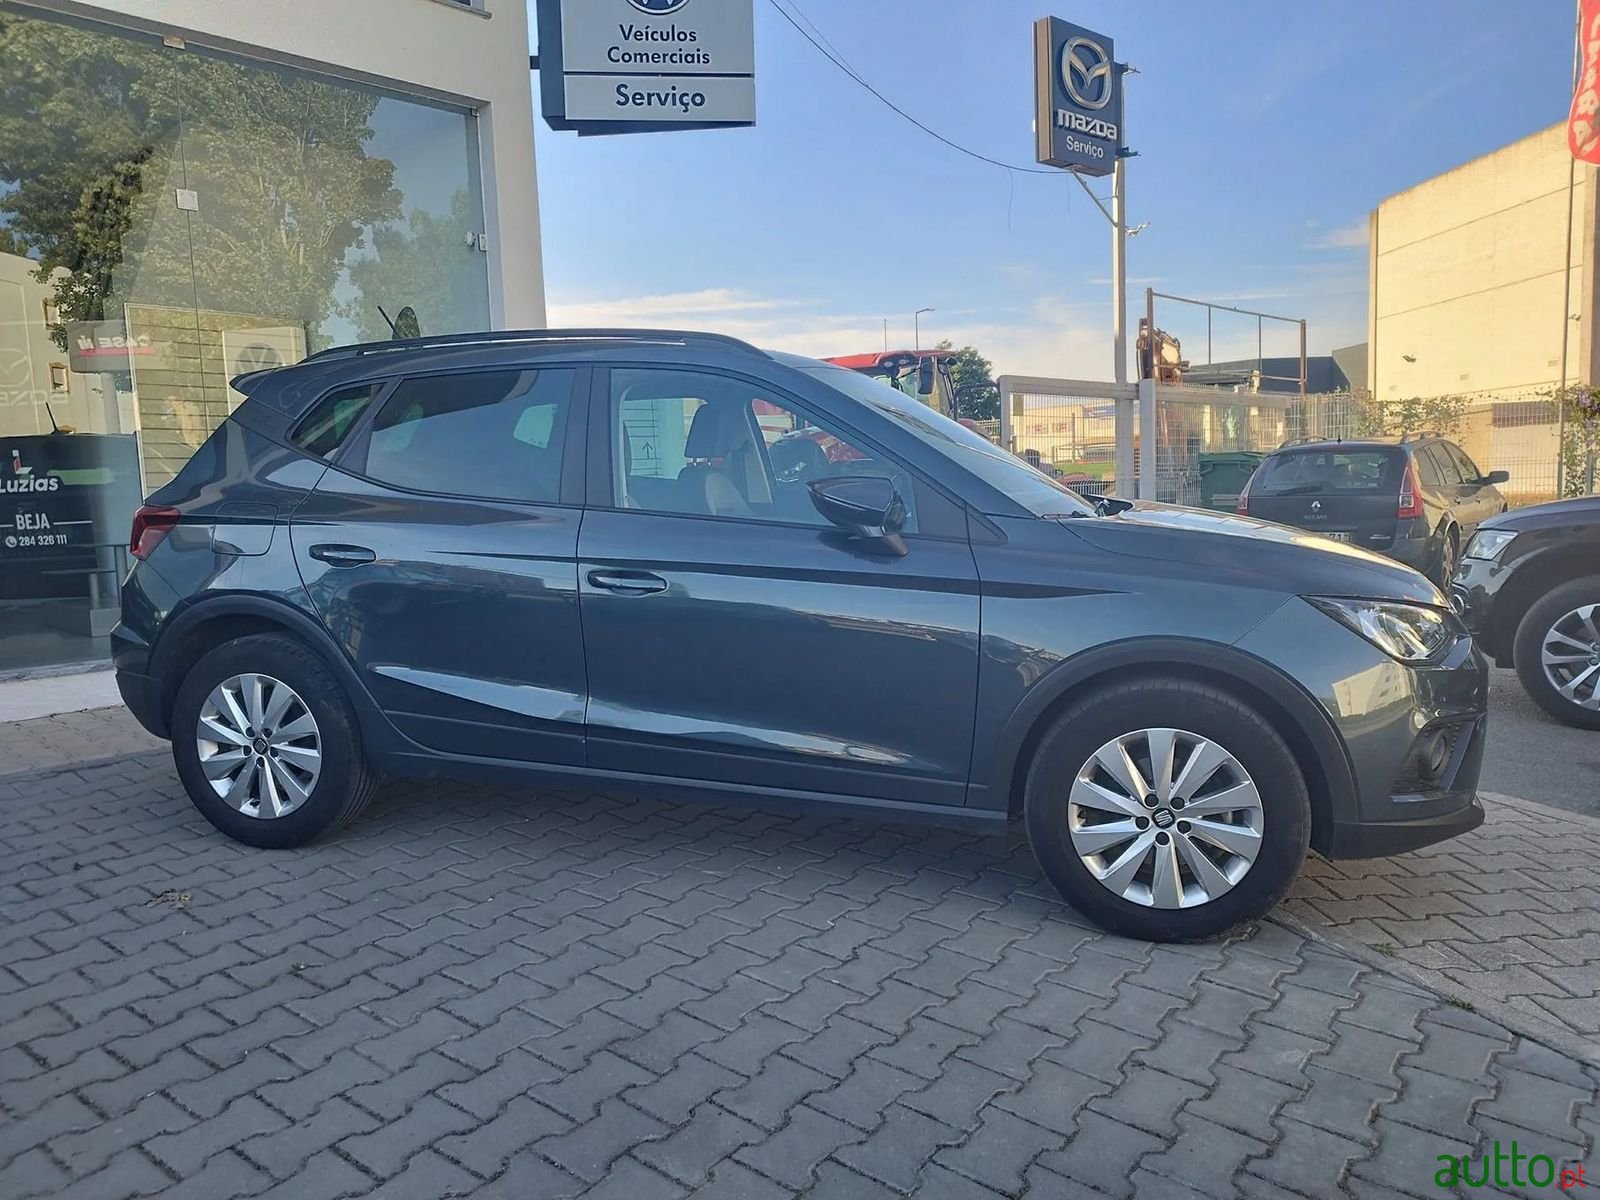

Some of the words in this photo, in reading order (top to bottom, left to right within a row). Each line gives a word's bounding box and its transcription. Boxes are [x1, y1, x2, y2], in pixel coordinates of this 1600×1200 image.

[619, 24, 697, 42] Veículos
[607, 46, 711, 64] Comerciais
[615, 83, 706, 113] Serviço
[1066, 135, 1104, 159] Serviço
[0, 475, 59, 494] Luzias
[15, 513, 51, 530] BEJA
[19, 535, 36, 547] 284
[56, 534, 68, 545] 111
